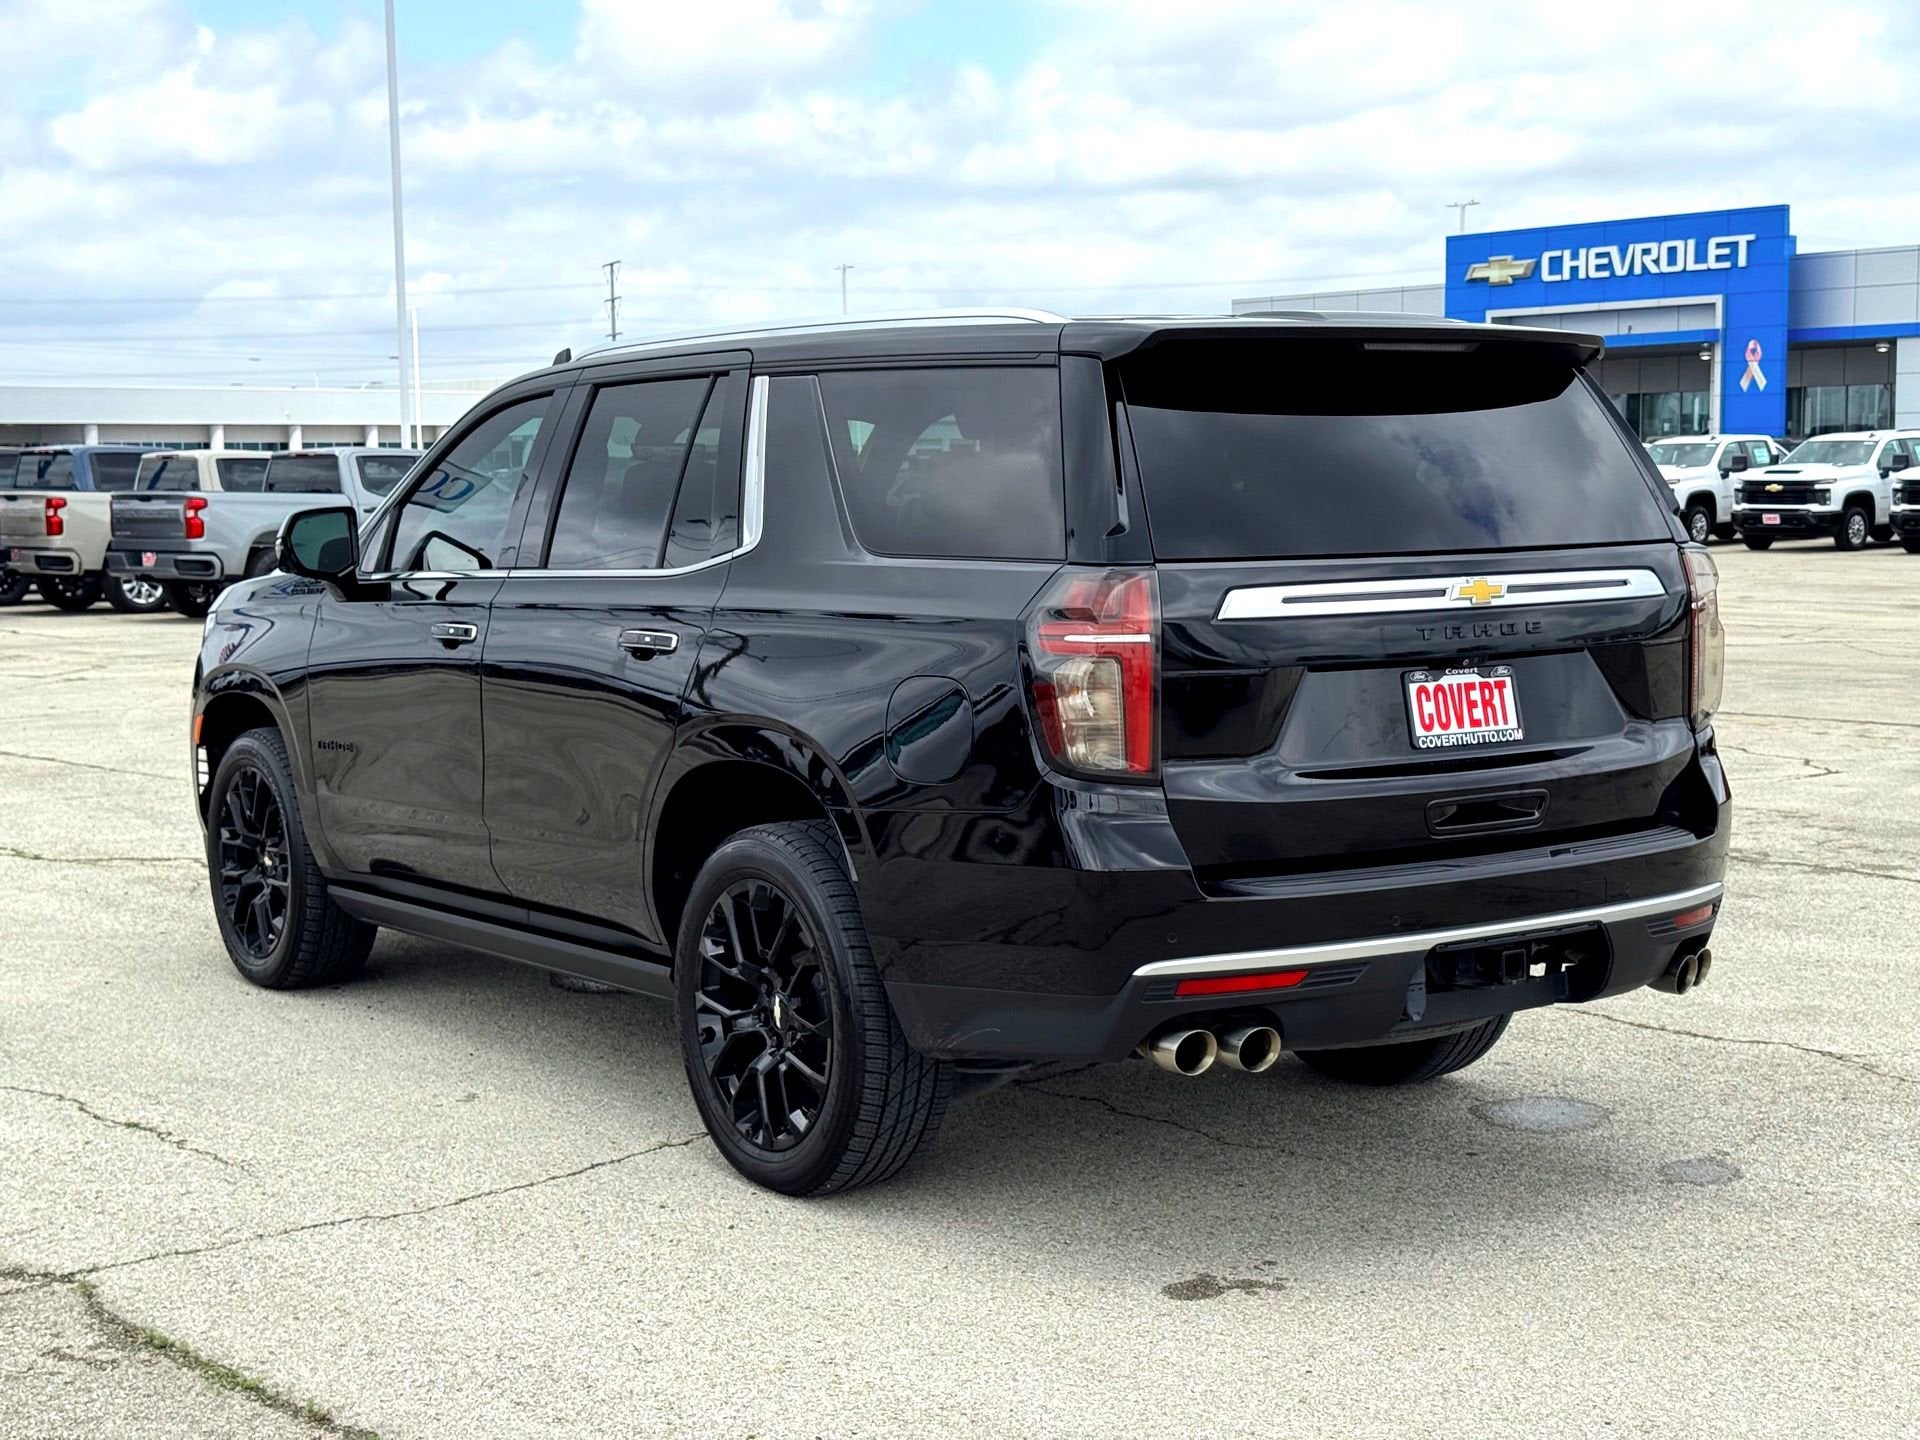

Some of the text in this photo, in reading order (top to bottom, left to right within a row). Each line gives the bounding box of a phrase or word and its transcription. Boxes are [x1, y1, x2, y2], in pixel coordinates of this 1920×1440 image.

[1541, 233, 1757, 282] CHEVROLET
[1416, 621, 1543, 641] TAHOE
[1445, 667, 1479, 675] Covert
[1416, 679, 1509, 733] COVERT
[1419, 729, 1524, 749] COVERTHUTTO.COM
